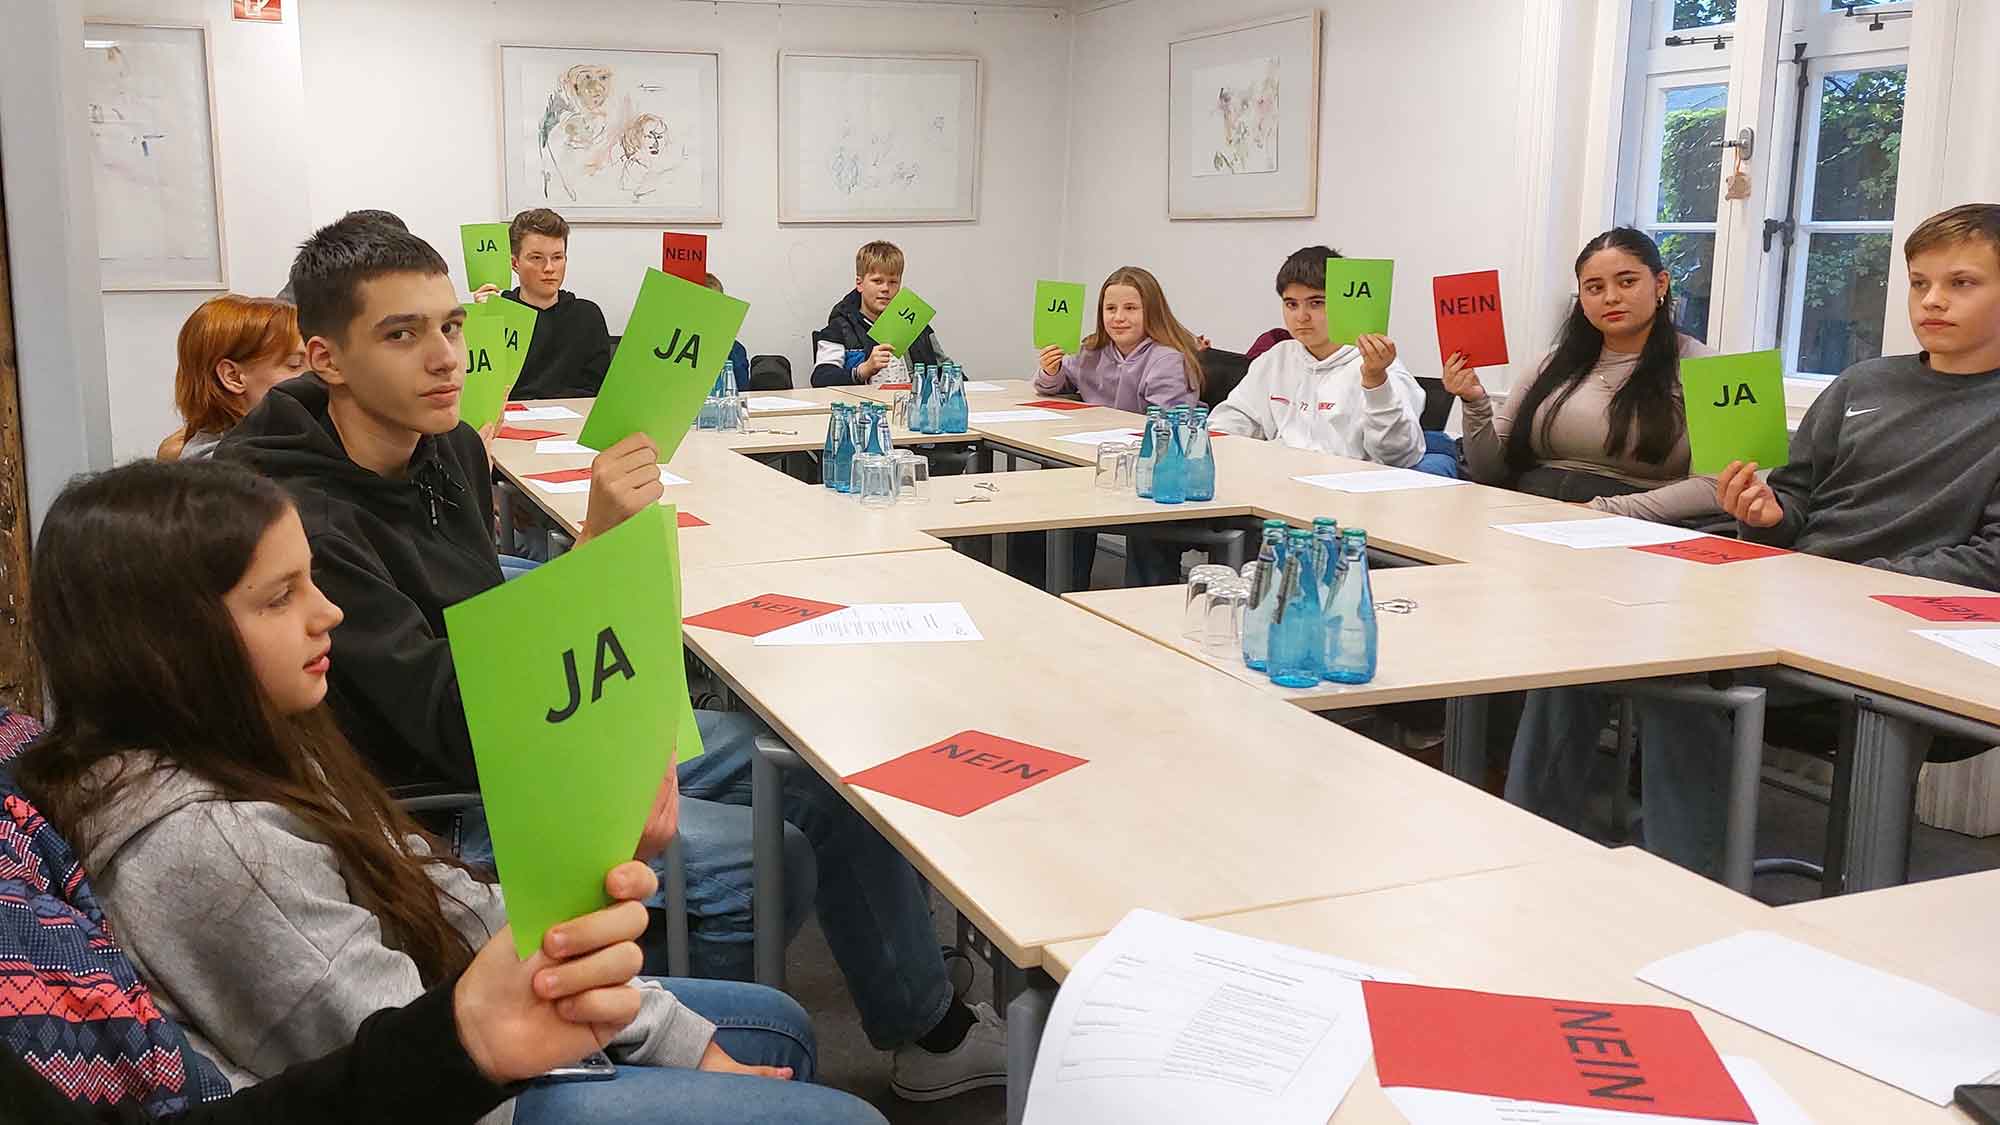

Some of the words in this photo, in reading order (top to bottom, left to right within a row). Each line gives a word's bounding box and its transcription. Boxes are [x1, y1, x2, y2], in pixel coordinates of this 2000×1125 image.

[476, 239, 498, 252] JA
[665, 247, 704, 262] NEIN
[1342, 280, 1373, 299] JA
[898, 306, 918, 325] JA
[1047, 298, 1069, 314] JA
[1439, 293, 1497, 317] NEIN
[653, 326, 701, 370] JA
[466, 348, 493, 374] JA
[1712, 382, 1758, 408] JA
[744, 600, 820, 618] NEIN
[545, 625, 636, 724] JA
[930, 742, 1050, 782] NEIN
[1552, 1004, 1656, 1103] NEIN
